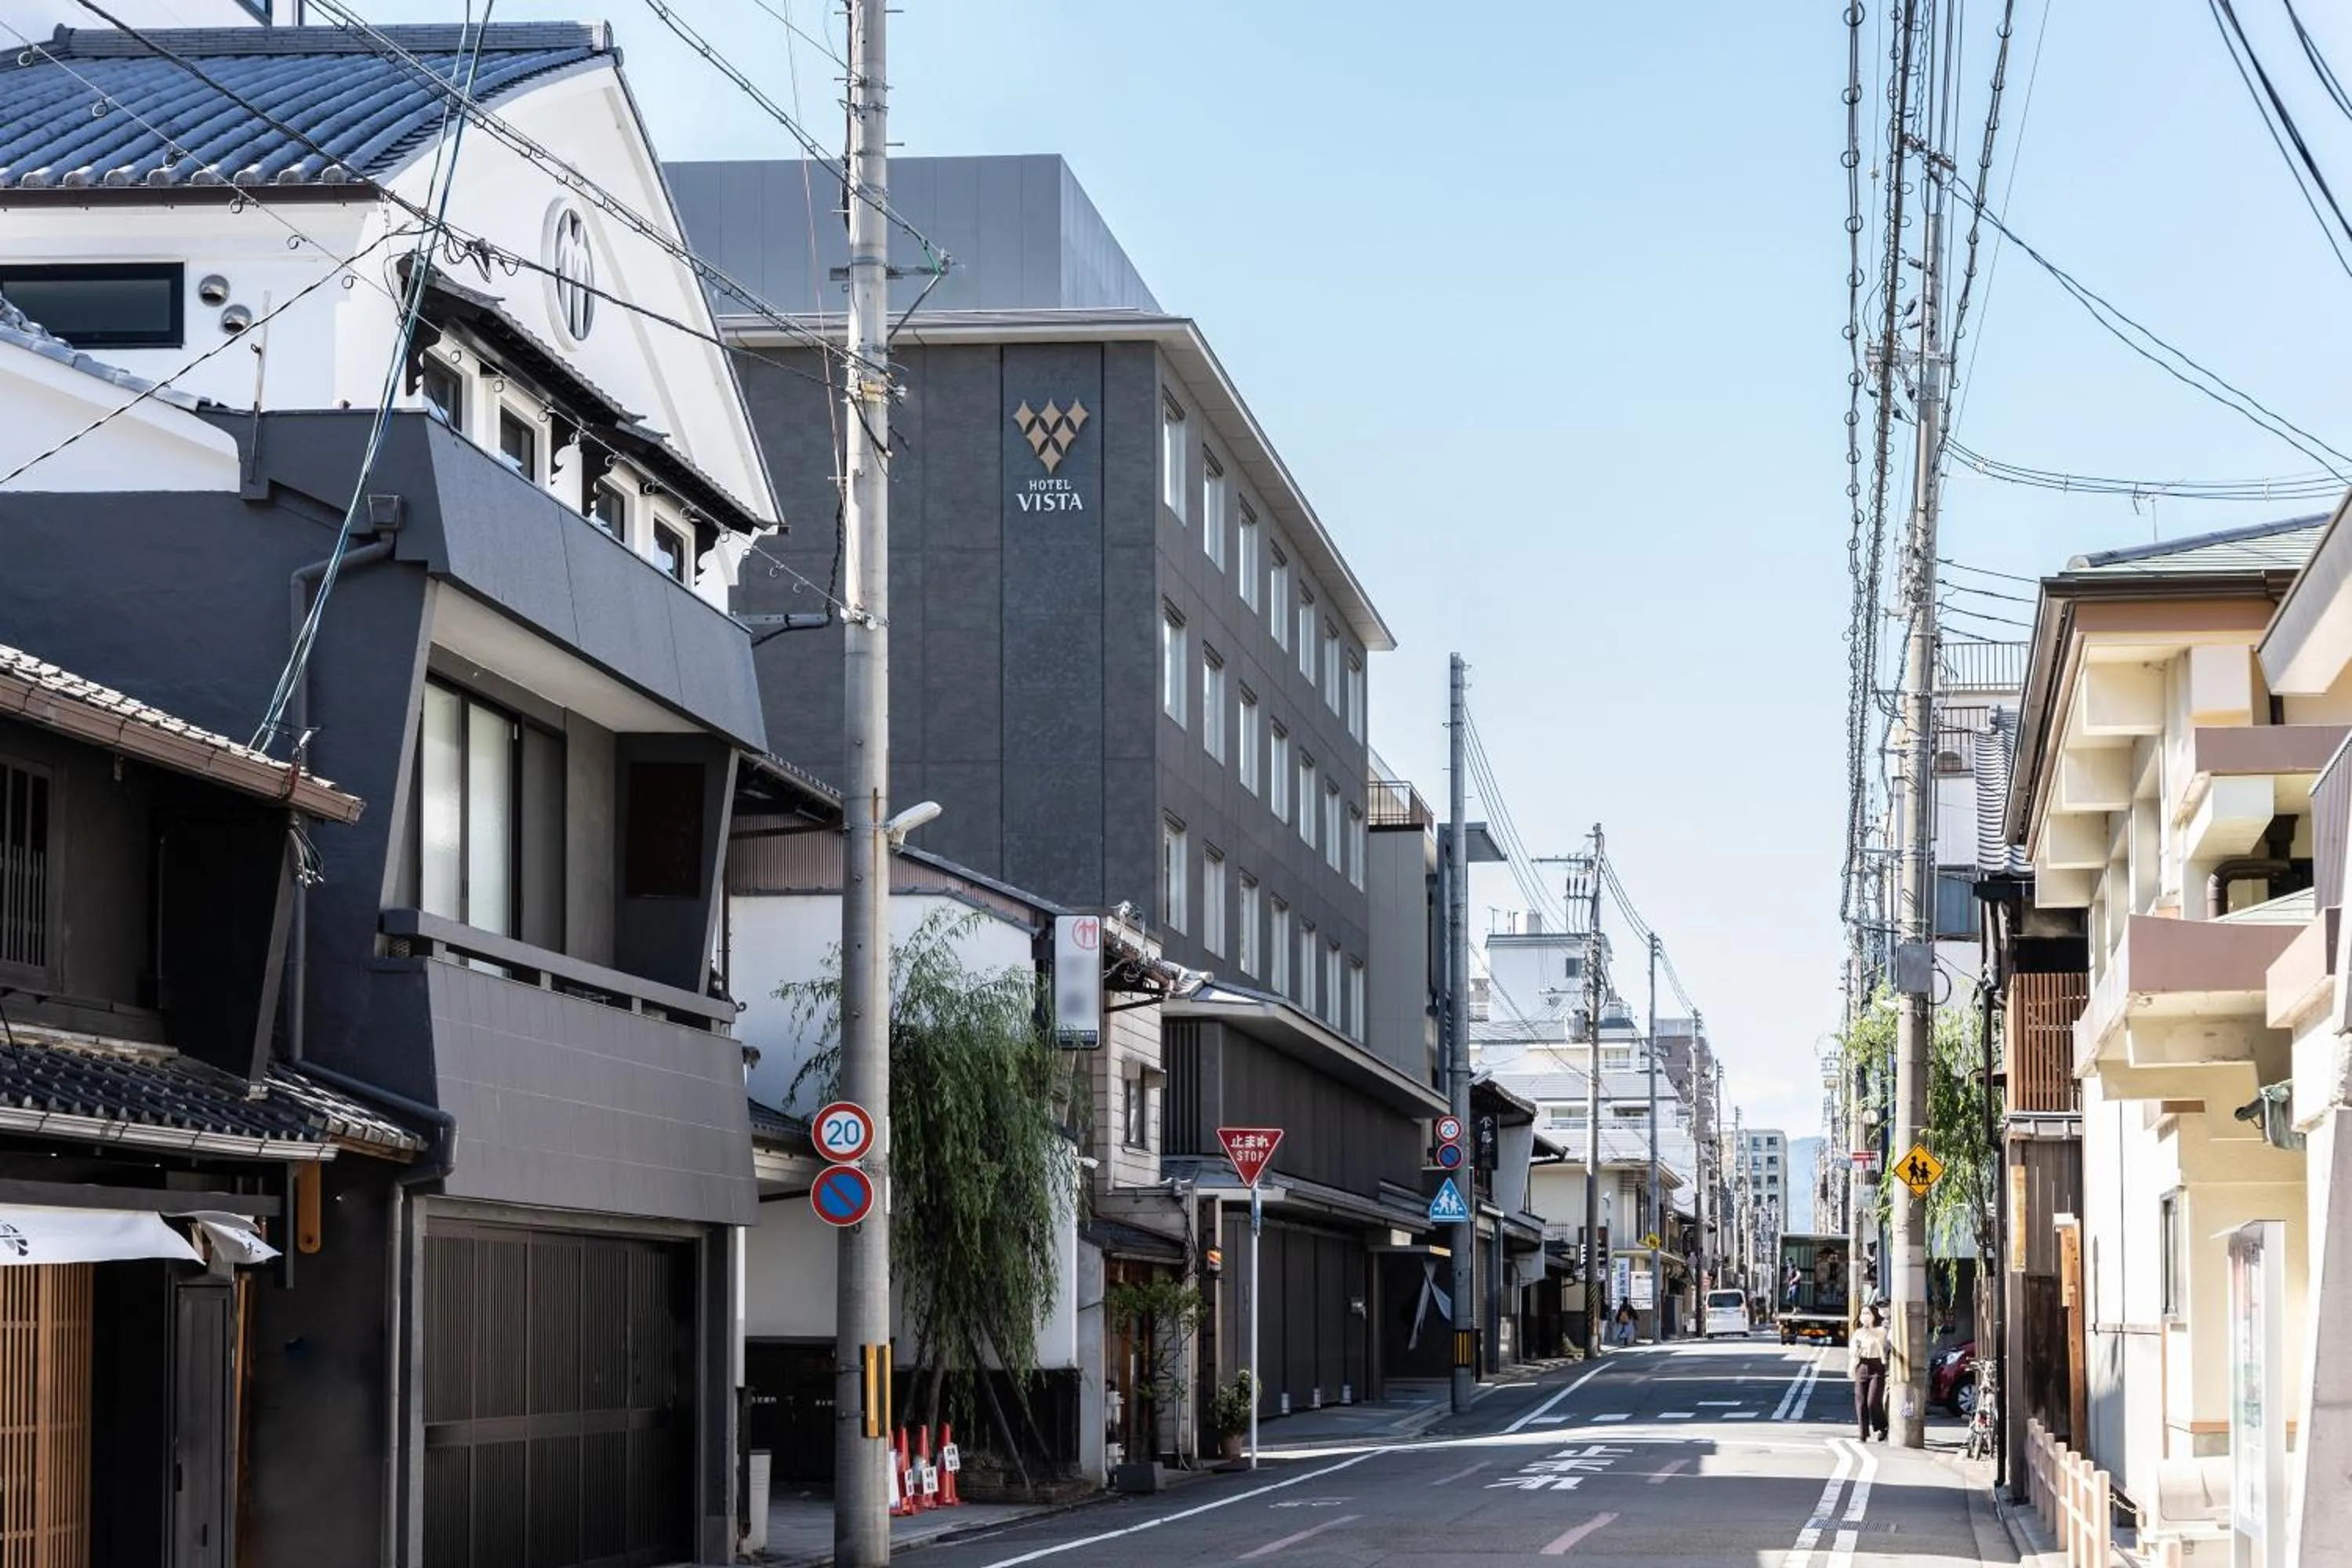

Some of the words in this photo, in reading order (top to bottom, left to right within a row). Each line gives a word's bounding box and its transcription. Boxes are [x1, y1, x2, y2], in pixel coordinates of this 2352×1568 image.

[1029, 479, 1072, 491] HOTEL
[1016, 493, 1083, 511] VISTA
[826, 1119, 860, 1145] 20
[1230, 1135, 1270, 1148] 止まれ
[1236, 1150, 1265, 1162] STOP
[1484, 1445, 1633, 1490] 止まれ
